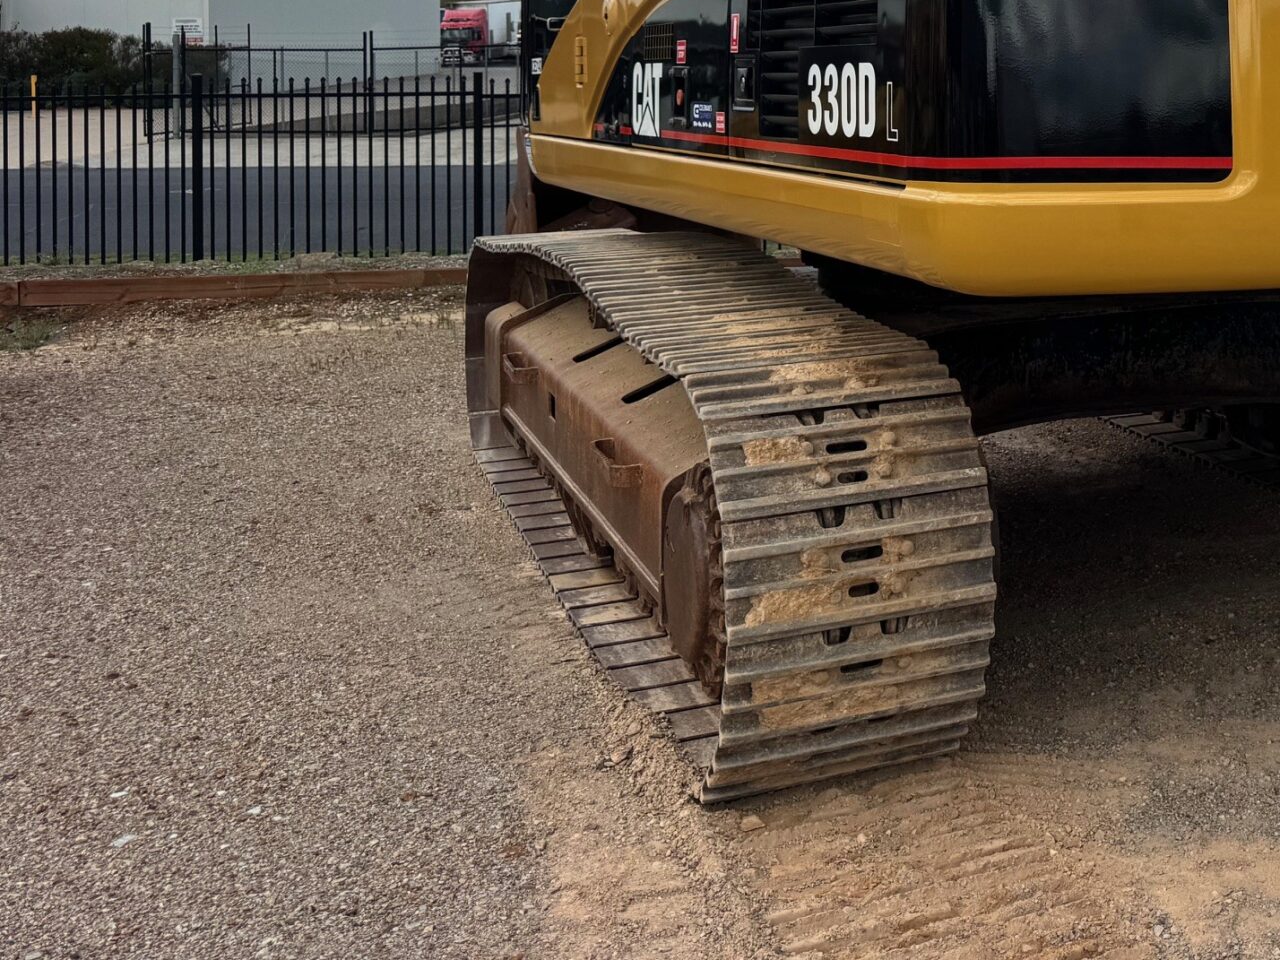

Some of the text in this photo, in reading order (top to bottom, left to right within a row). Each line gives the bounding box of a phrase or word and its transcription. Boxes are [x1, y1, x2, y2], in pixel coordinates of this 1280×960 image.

[632, 62, 663, 138] CAT
[807, 62, 899, 142] 330D L
